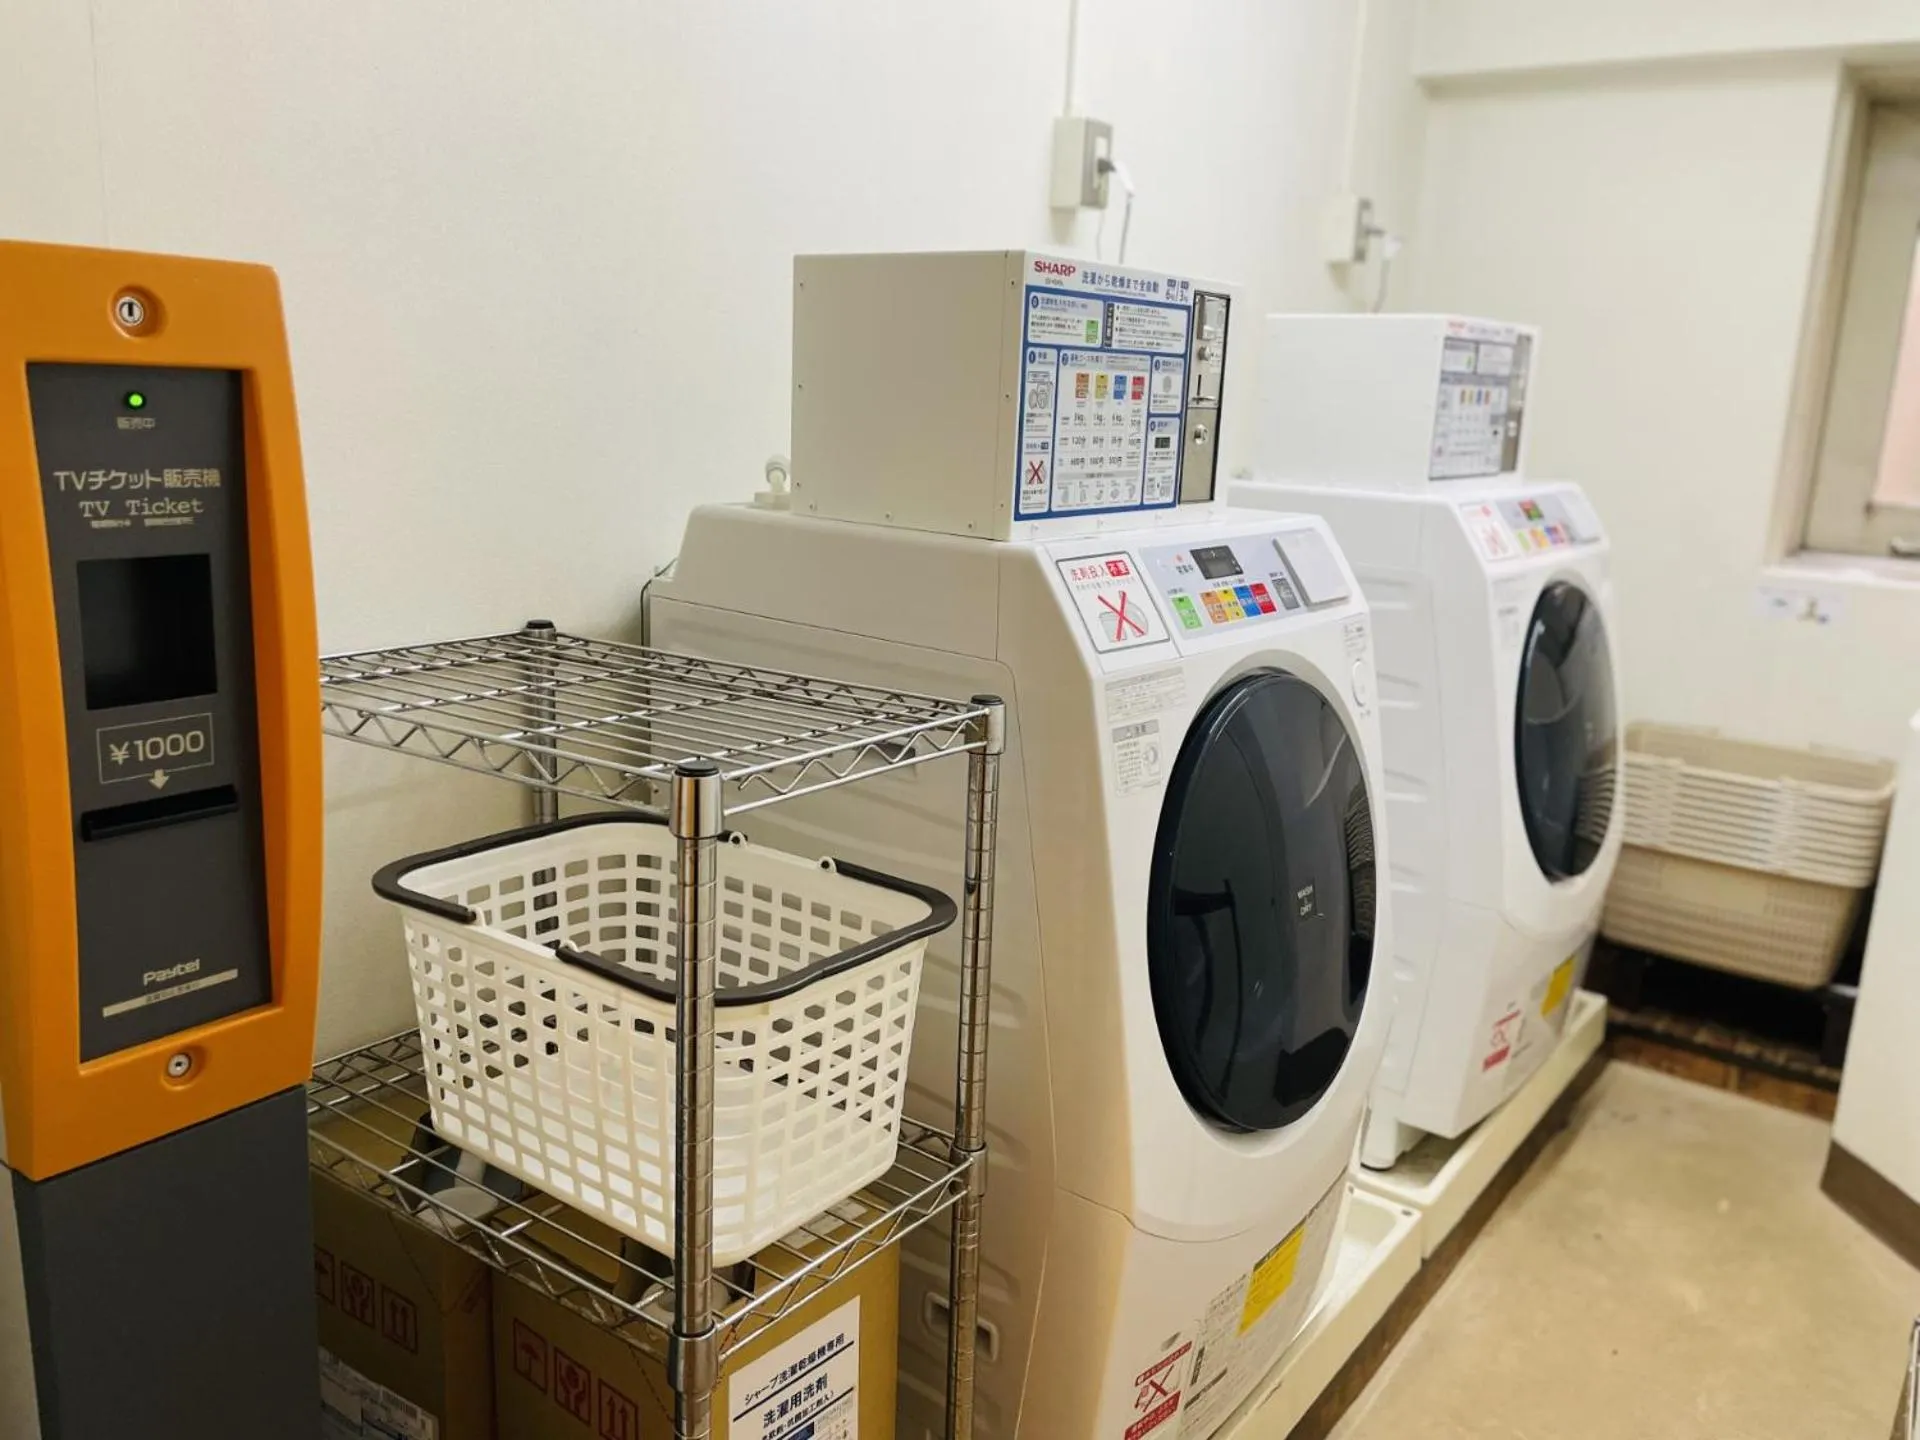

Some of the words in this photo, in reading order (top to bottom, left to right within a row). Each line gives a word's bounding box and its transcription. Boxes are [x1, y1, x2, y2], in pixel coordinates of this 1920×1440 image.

[1034, 260, 1076, 277] SHARP
[1082, 271, 1160, 294] 洗濯から乾燥まで全自動
[53, 468, 221, 491] TVチケット販売機
[79, 500, 111, 517] TV
[125, 496, 205, 516] Ticket
[109, 730, 204, 766] ¥1000
[744, 1332, 845, 1406] シャープ洗濯乾燥機専用
[763, 1372, 828, 1429] 洗濯用洗剤
